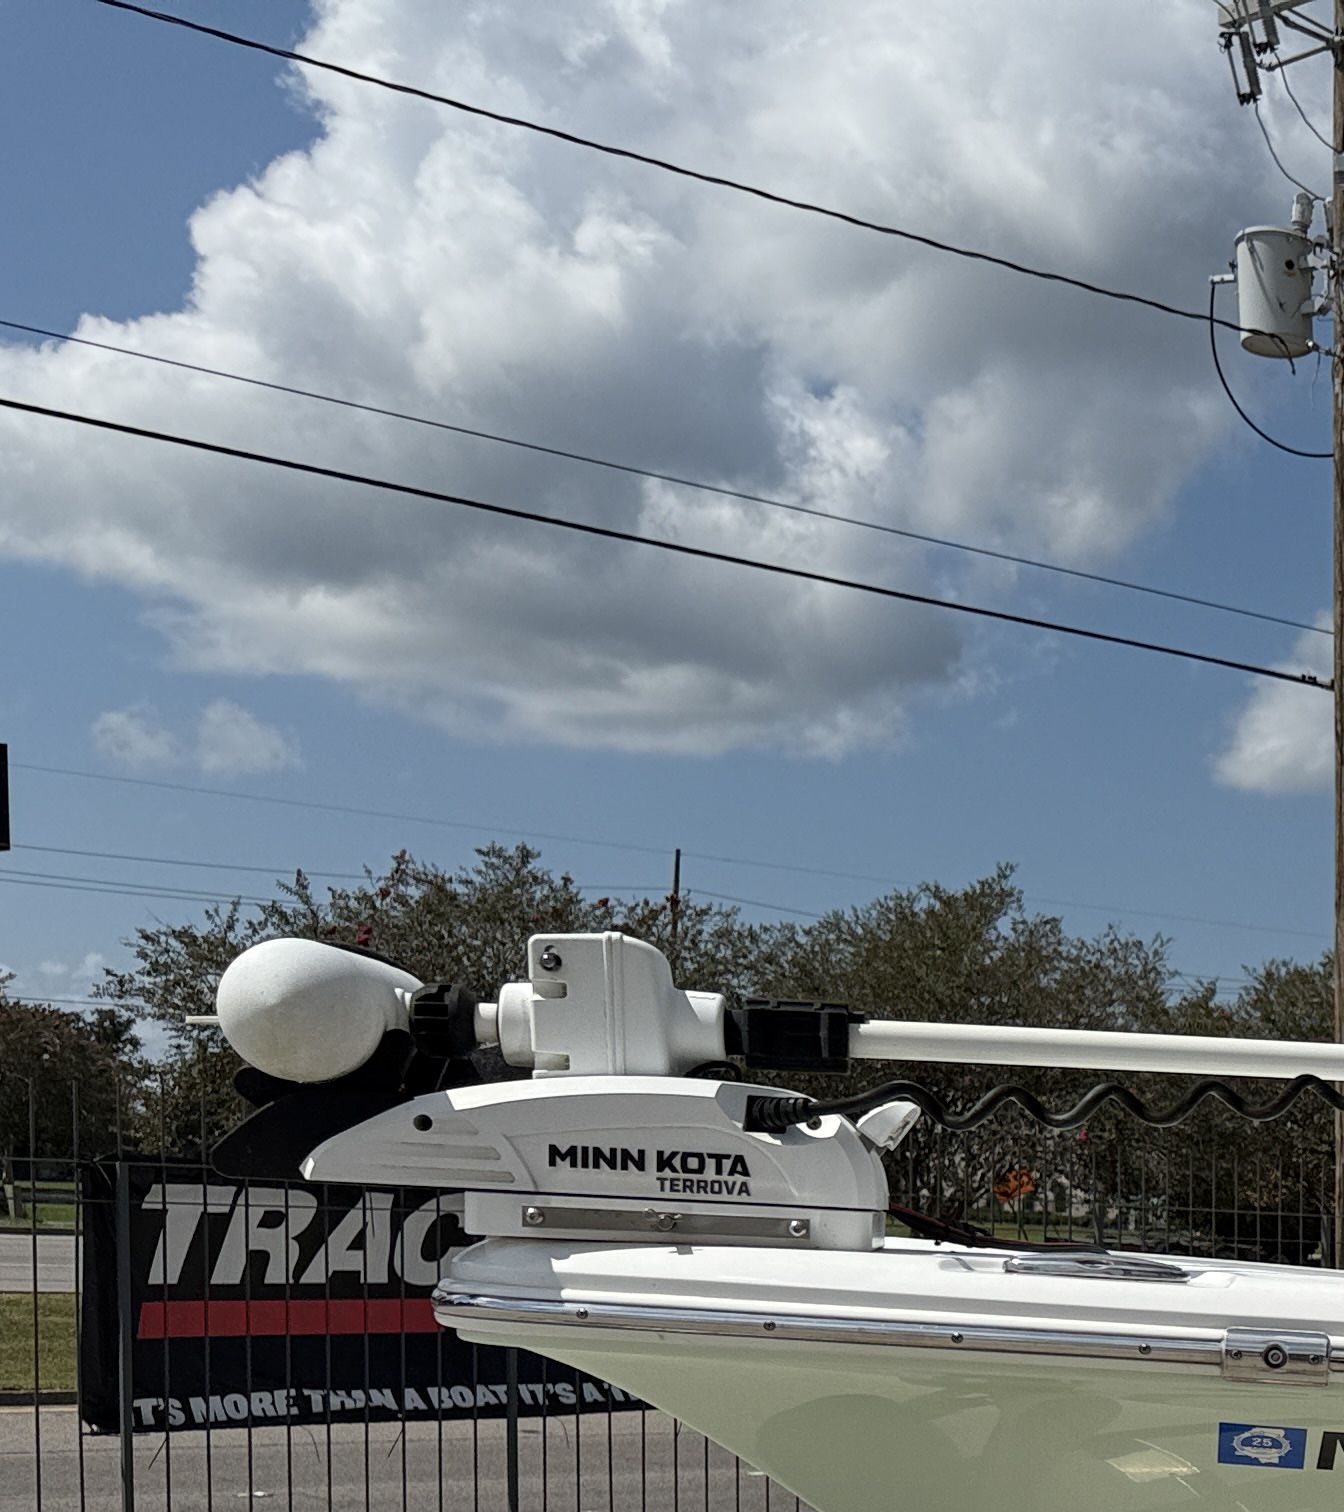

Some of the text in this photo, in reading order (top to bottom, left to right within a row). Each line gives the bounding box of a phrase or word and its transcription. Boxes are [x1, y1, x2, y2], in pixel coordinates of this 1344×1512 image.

[548, 1143, 752, 1178] MINN KOTA
[656, 1177, 752, 1197] TERROVA
[188, 1387, 300, 1425] MORE
[404, 1387, 428, 1411] A
[427, 1384, 509, 1411] BOAT
[518, 1382, 577, 1406] IT'S
[582, 1382, 606, 1403] A
[1251, 1437, 1273, 1447] 25
